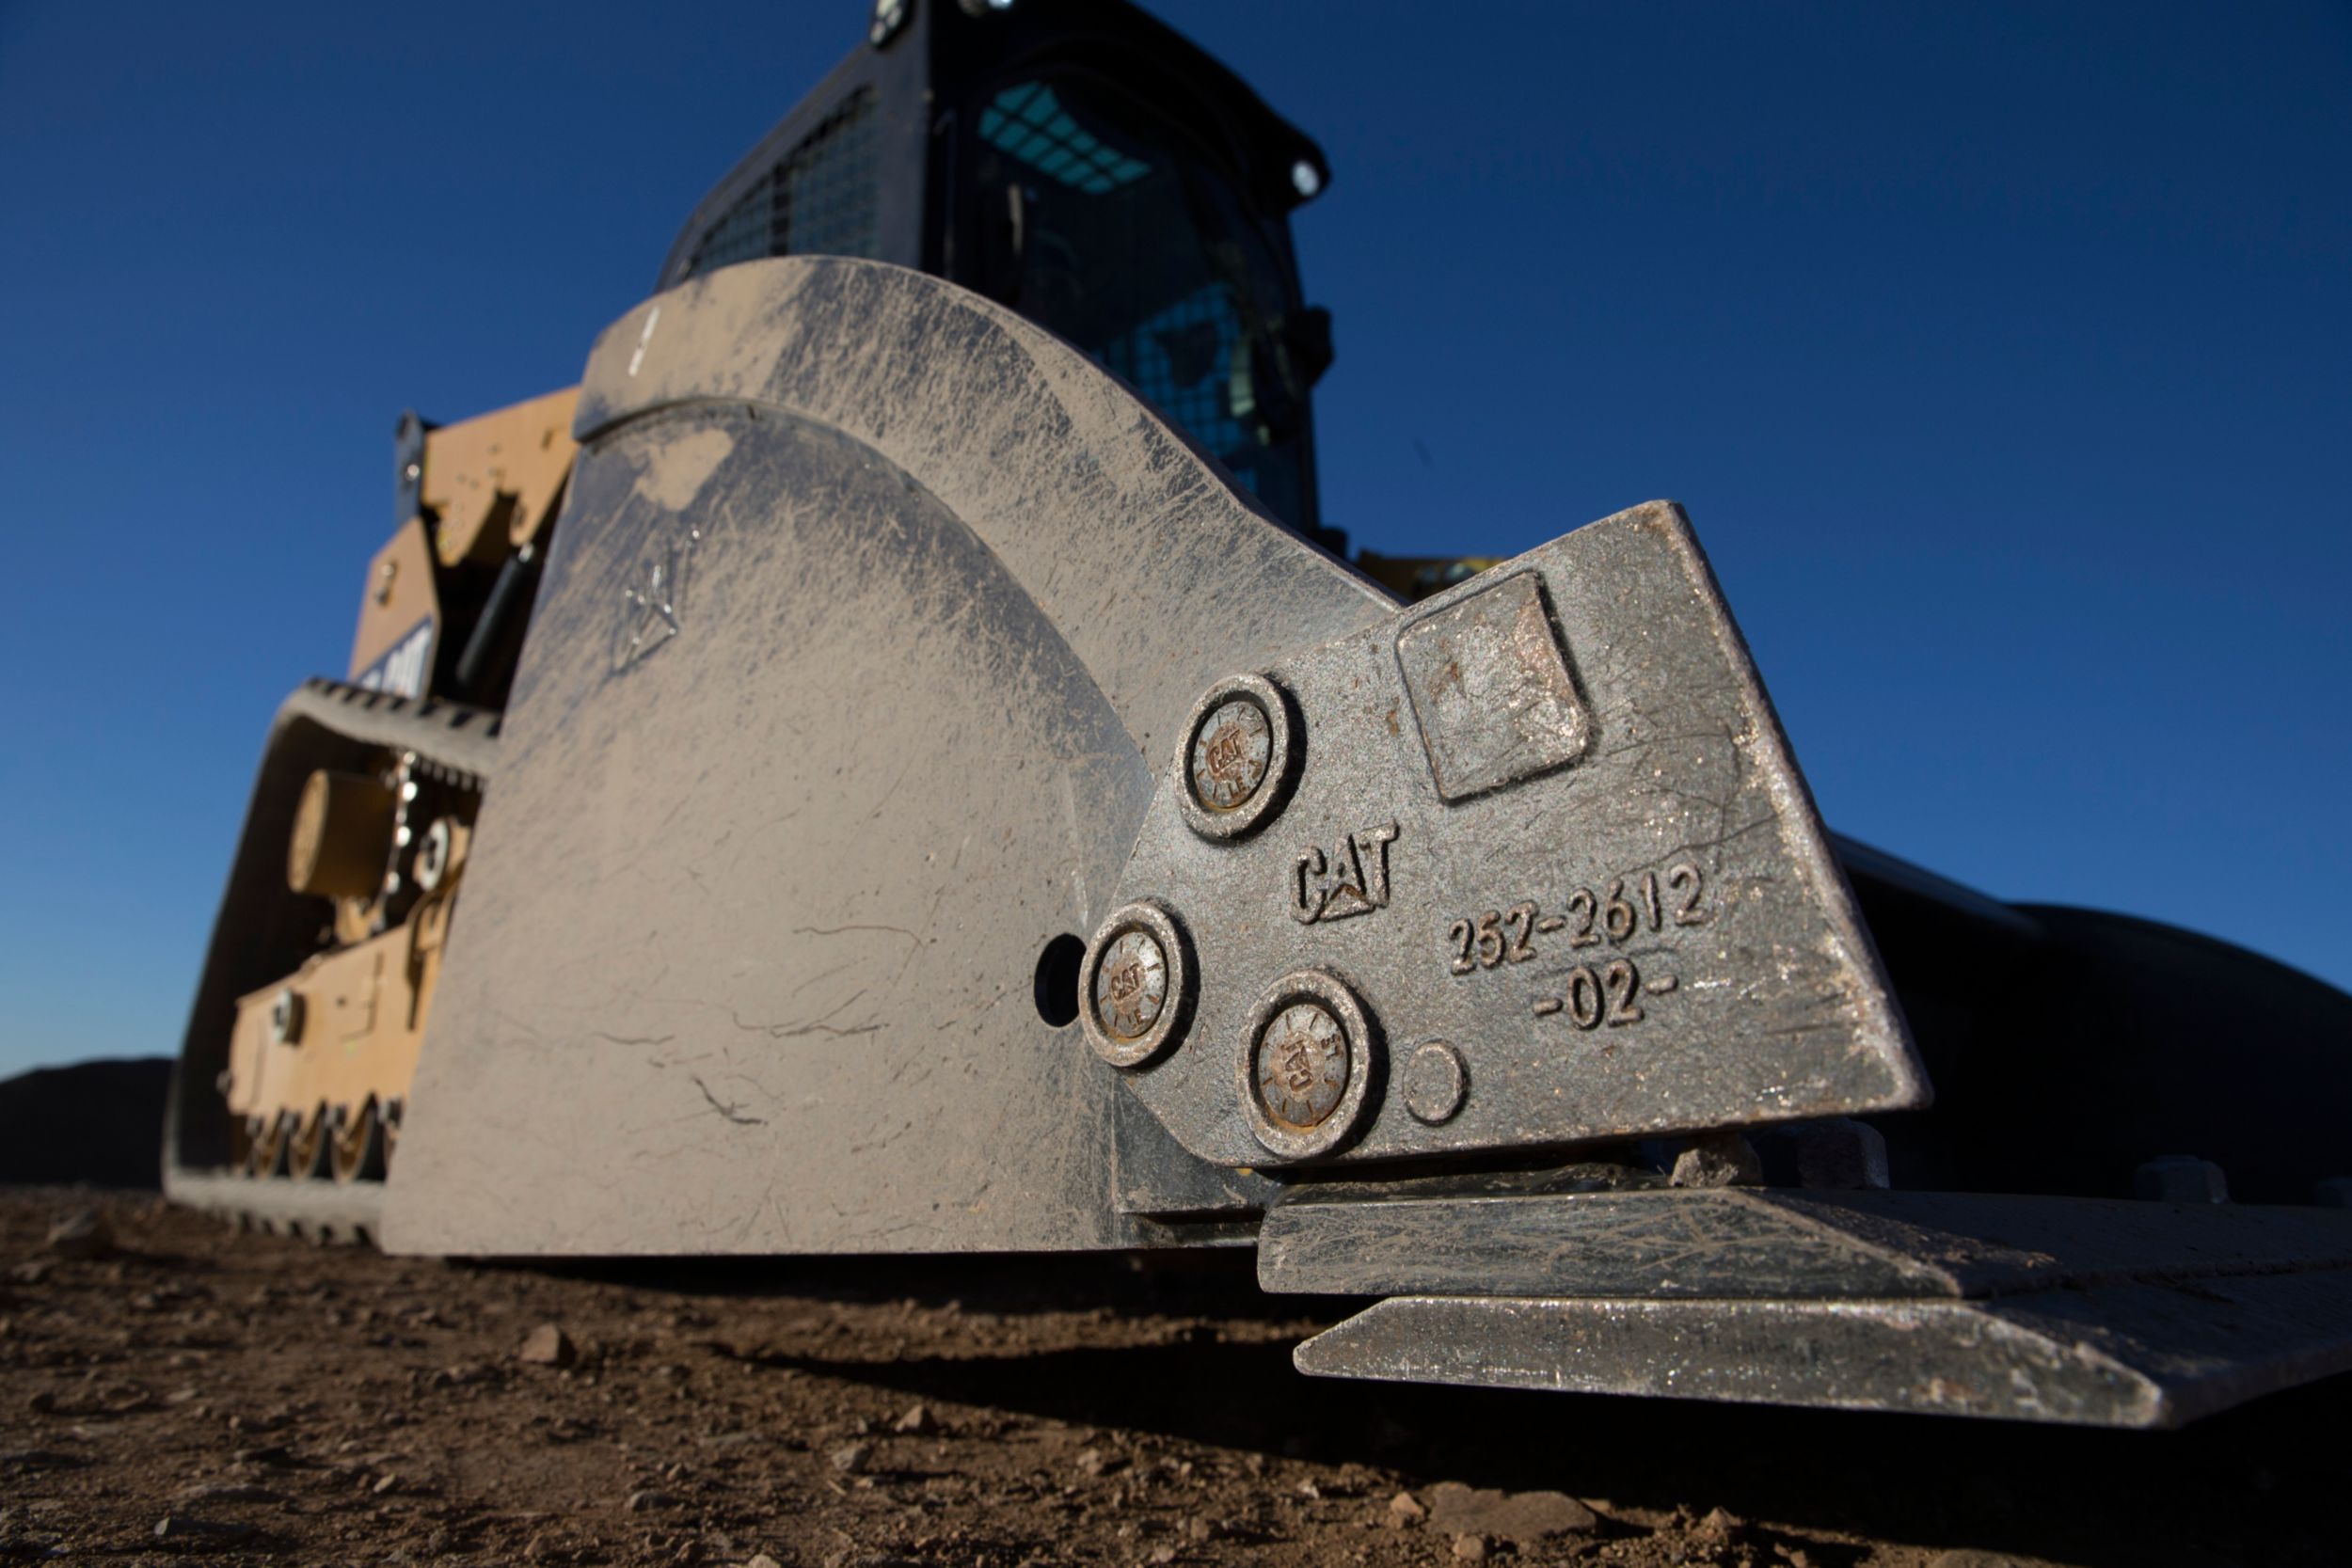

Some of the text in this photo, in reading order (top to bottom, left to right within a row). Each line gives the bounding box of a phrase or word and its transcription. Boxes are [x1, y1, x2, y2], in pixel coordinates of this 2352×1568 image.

[1209, 730, 1241, 773] CAT
[1292, 819, 1400, 925] CAT
[1450, 862, 1708, 976] 252-2612
[1111, 962, 1139, 1001] CAT
[1532, 958, 1678, 1032] -02-
[1280, 1039, 1314, 1093] CAT
